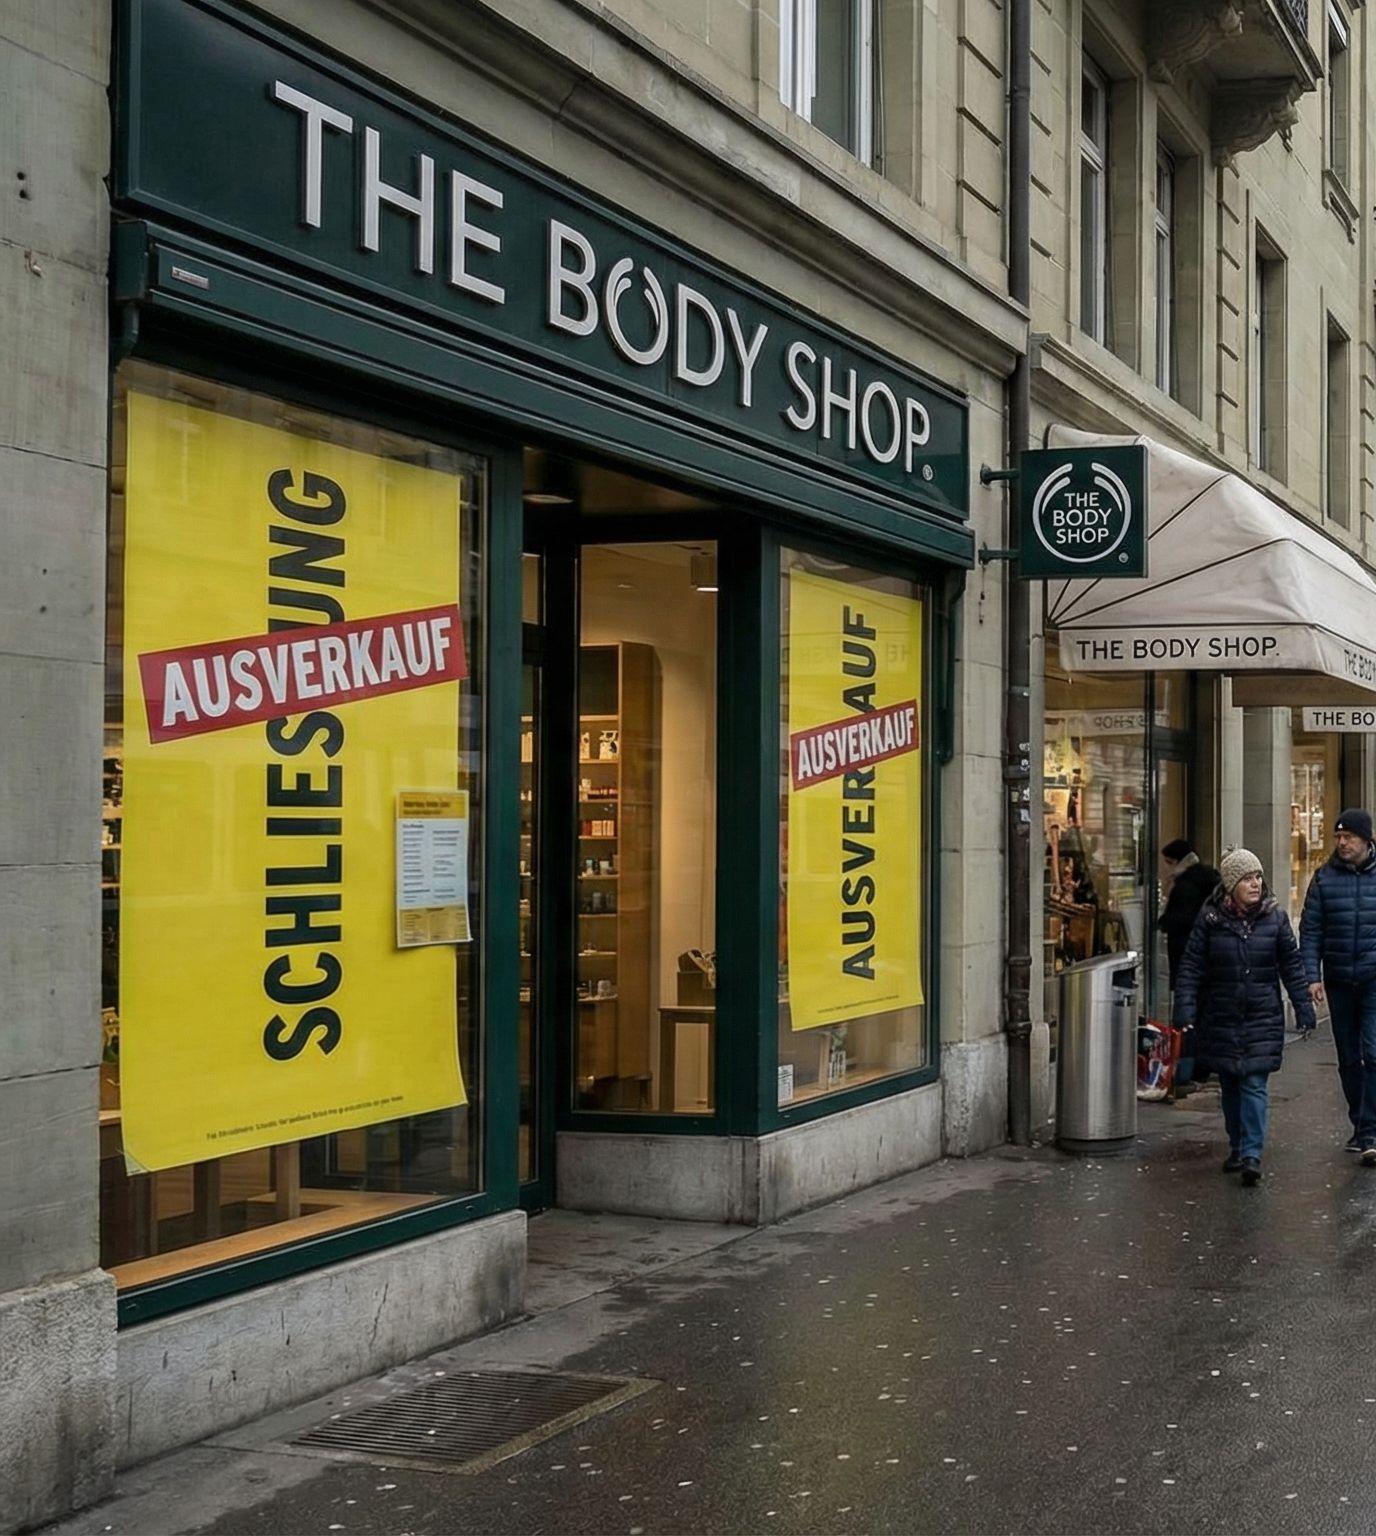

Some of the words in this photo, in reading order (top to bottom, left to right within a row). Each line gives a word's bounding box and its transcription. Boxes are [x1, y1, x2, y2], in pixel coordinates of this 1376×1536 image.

[274, 79, 506, 305] THE
[549, 218, 769, 408] BODY
[784, 341, 931, 473] SHOP
[1052, 507, 1113, 527] BODY
[1064, 491, 1101, 508] THE
[1056, 527, 1110, 544] SHOP
[161, 616, 452, 728] AUSVERKAUF
[1076, 639, 1124, 660] THE
[1133, 637, 1201, 659] BODY
[1312, 711, 1346, 726] THE
[263, 468, 347, 1062] SCHLIESUNG
[797, 706, 915, 781] AUSVERKAUF
[841, 604, 877, 981] AUSVERAUF
